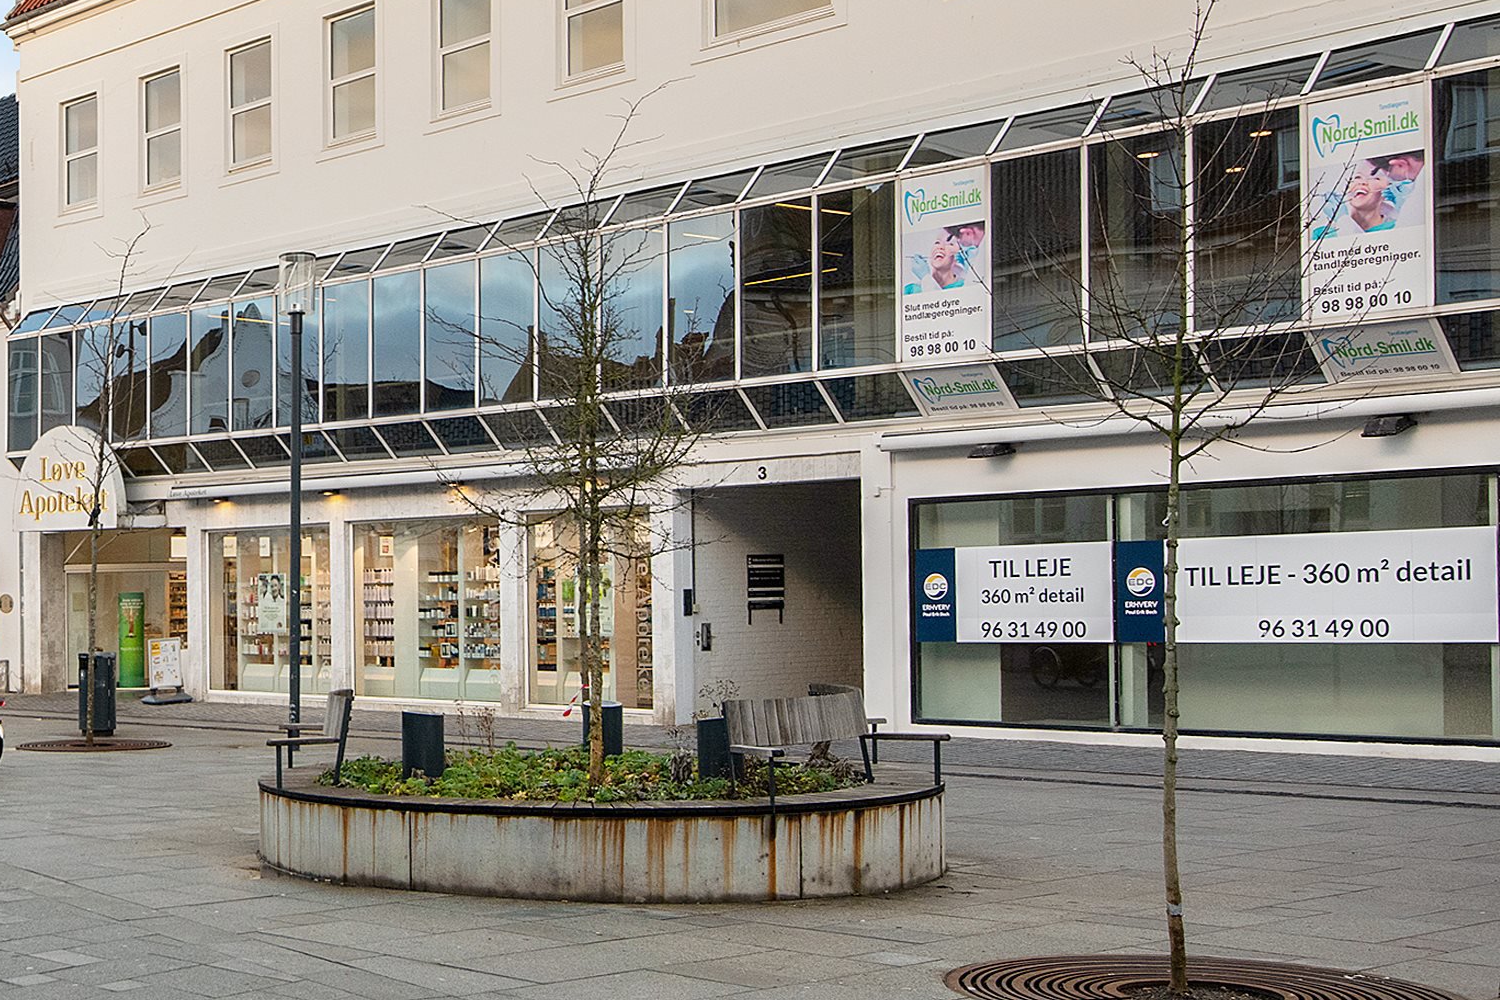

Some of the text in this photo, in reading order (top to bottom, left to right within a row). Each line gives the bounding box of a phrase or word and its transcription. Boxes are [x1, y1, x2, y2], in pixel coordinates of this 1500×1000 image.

[1322, 111, 1419, 144] Nord-Smil.dk
[911, 187, 982, 214] Nord-Smil.dk
[1313, 243, 1389, 261] Slut med dyre
[1313, 250, 1421, 271] tandlægeregninger.
[1313, 279, 1382, 296] Bestil tid på:
[904, 299, 960, 313] Slut med dyre
[1321, 290, 1411, 313] 98 98 00 10
[904, 305, 983, 321] tandlægeregninger.
[904, 332, 927, 342] Bestil
[928, 331, 940, 339] tid
[910, 338, 976, 357] 98 98 00 10
[1335, 337, 1436, 359] Nord-Smil.dk
[923, 378, 998, 396] Nord-Smil.dk
[39, 456, 86, 483] Løve
[758, 466, 767, 480] 3
[988, 558, 1072, 578] TIL LEJE
[1184, 566, 1221, 586] TIL
[1227, 564, 1281, 585] LEJE
[1302, 563, 1350, 584] 360
[1357, 558, 1390, 583] m²
[1396, 558, 1472, 582] detail
[925, 582, 947, 591] EDC
[1128, 577, 1154, 586] EDC
[981, 586, 1085, 604] 360 m² detail
[981, 620, 1087, 638] 96 31 49 00
[1258, 618, 1390, 638] 96 31 49 00
